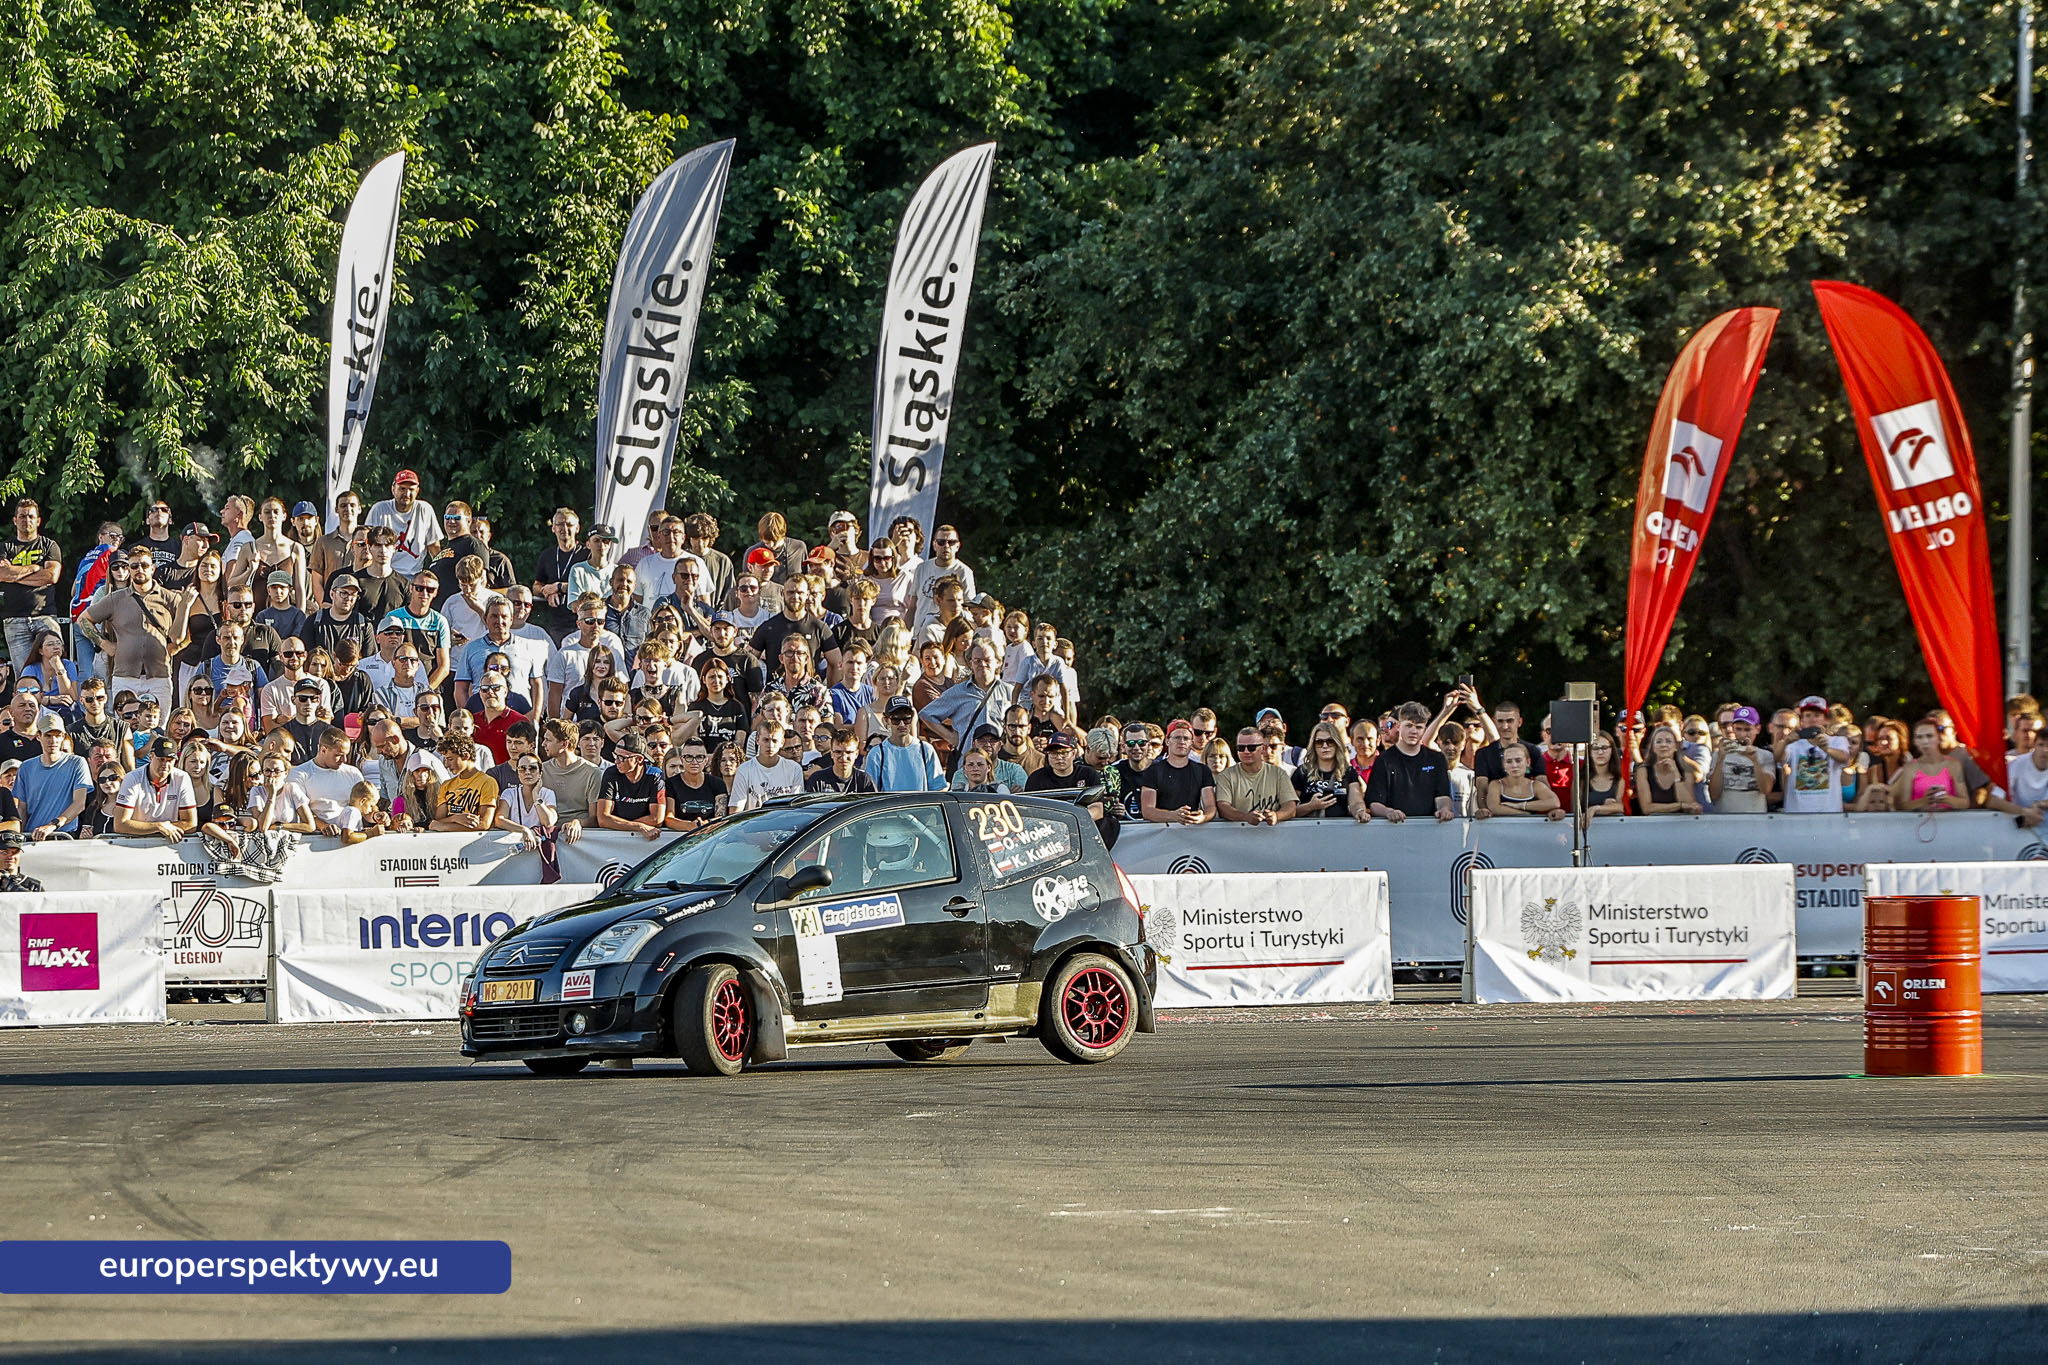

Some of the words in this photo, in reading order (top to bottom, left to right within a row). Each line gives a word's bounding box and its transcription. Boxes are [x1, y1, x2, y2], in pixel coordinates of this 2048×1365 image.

[969, 800, 1024, 840] 230
[1011, 855, 1027, 868] K.
[1027, 841, 1065, 862] Kuklis
[157, 863, 204, 876] STADION
[380, 857, 427, 872] STADION
[430, 855, 469, 874] ŚLĄSKI
[172, 880, 234, 948] 70
[825, 904, 896, 924] #rajdslaska
[1183, 907, 1303, 926] Ministerstwo
[1589, 903, 1709, 921] Ministerstwo
[1985, 917, 2046, 937] Sportu
[28, 938, 55, 948] RMF
[173, 936, 192, 949] LAT
[1183, 933, 1244, 952] Sportu
[1250, 931, 1255, 948] i
[1260, 928, 1344, 949] Turystyki
[1589, 928, 1649, 948] Sportu
[1655, 927, 1660, 944] i
[1665, 926, 1748, 946] Turystyki
[174, 952, 223, 964] LEGENDY
[484, 983, 497, 1001] W8
[506, 981, 533, 1000] 291Y
[1903, 979, 1946, 989] ORLEN
[1903, 991, 1920, 1000] OIL
